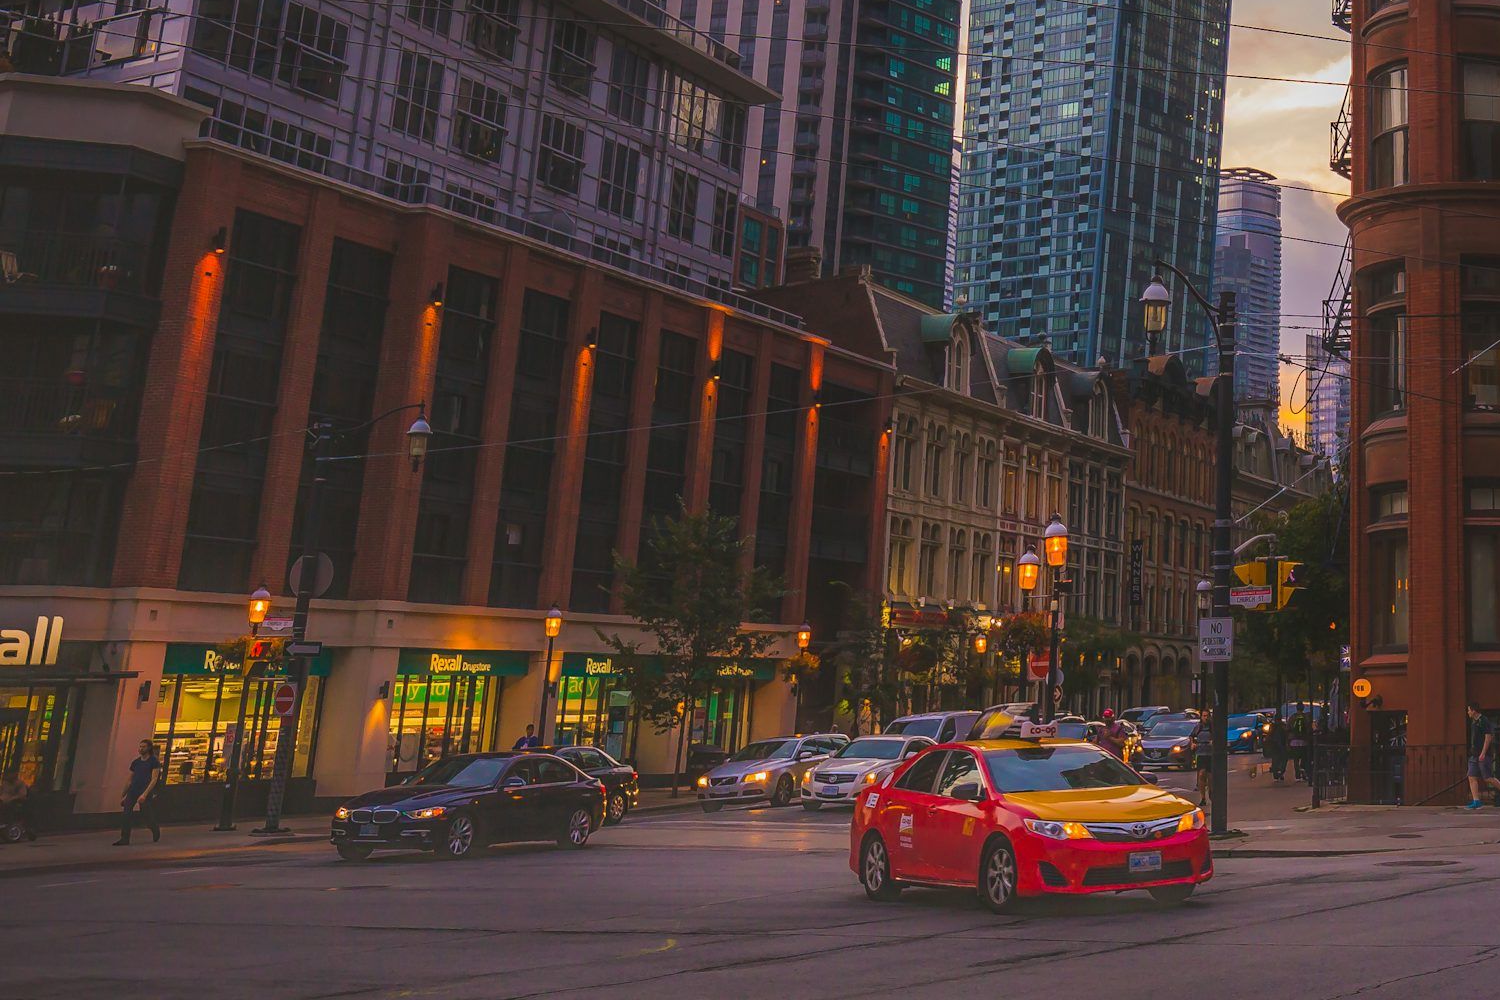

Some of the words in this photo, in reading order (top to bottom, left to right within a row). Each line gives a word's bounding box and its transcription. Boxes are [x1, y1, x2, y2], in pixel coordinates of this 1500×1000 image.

[1132, 544, 1143, 601] WINNERS
[1210, 622, 1223, 634] NO
[430, 653, 463, 673] Rexall
[462, 661, 492, 673] Drugstore
[586, 657, 612, 675] Rexall
[1030, 726, 1057, 736] co-op
